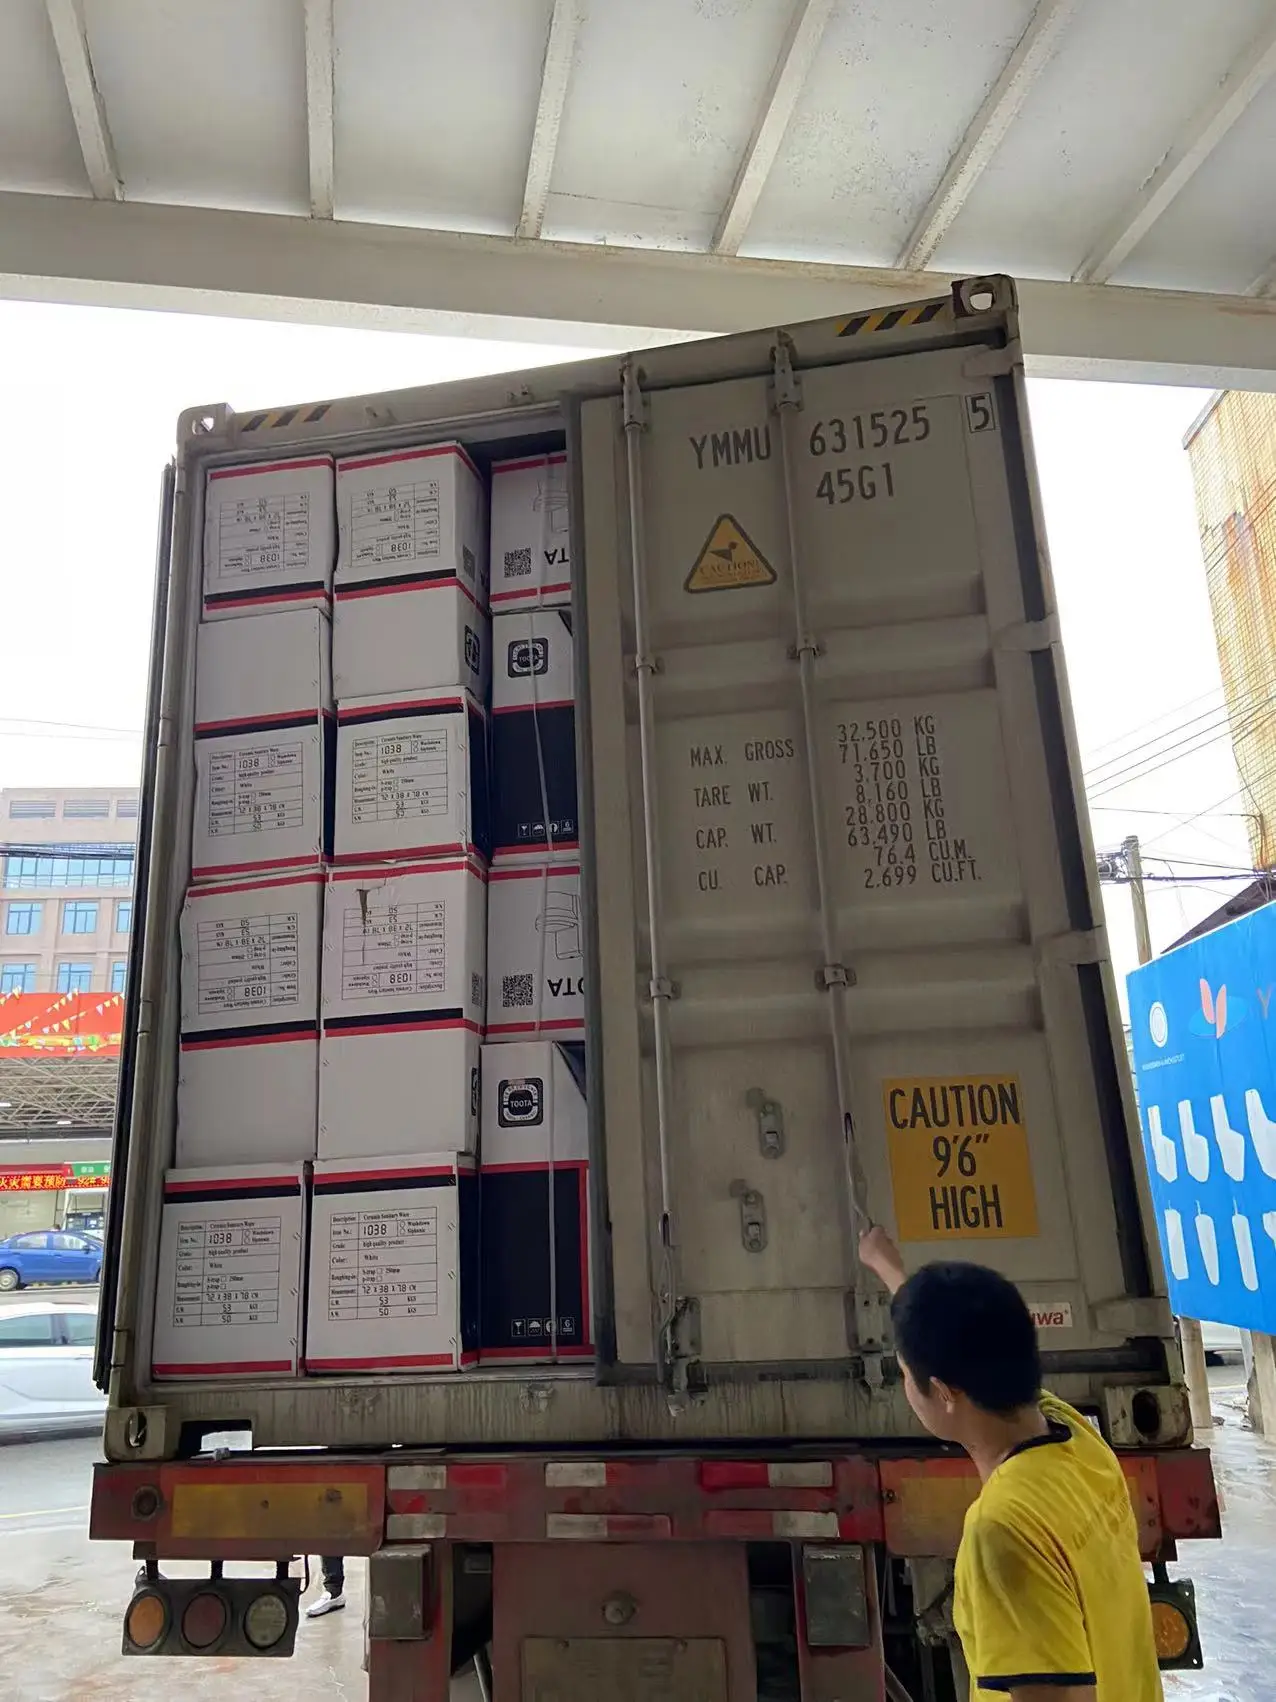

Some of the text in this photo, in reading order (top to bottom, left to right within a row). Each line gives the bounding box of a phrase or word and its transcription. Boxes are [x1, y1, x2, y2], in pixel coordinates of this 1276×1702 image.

[689, 396, 990, 470] YMMU 631525 5
[815, 462, 894, 505] 45G1
[391, 542, 411, 552] 1038
[260, 553, 280, 562] 1038
[914, 715, 935, 735] KG
[381, 744, 402, 754] 1038
[745, 739, 794, 761] GROSS
[916, 736, 936, 756] LB
[239, 759, 259, 769] 1038
[919, 756, 940, 777] KG
[694, 782, 773, 807] TARE WT.
[921, 777, 941, 798] LB
[923, 798, 944, 819] KG
[696, 823, 777, 848] CAP. WT.
[926, 819, 946, 840] LB
[754, 864, 787, 886] CAP.
[390, 973, 412, 984] 1038
[244, 986, 266, 997] 1038
[890, 1083, 1020, 1129] CAUTION
[929, 1184, 1003, 1229] HIGH
[209, 1233, 232, 1244] 1038
[363, 1224, 387, 1236] 1038
[362, 1286, 371, 1294] 72
[379, 1285, 388, 1293] 38
[398, 1284, 406, 1292] 78
[223, 1304, 231, 1312] 53
[379, 1297, 388, 1305] 53
[222, 1315, 232, 1323] 50
[379, 1308, 389, 1316] 50
